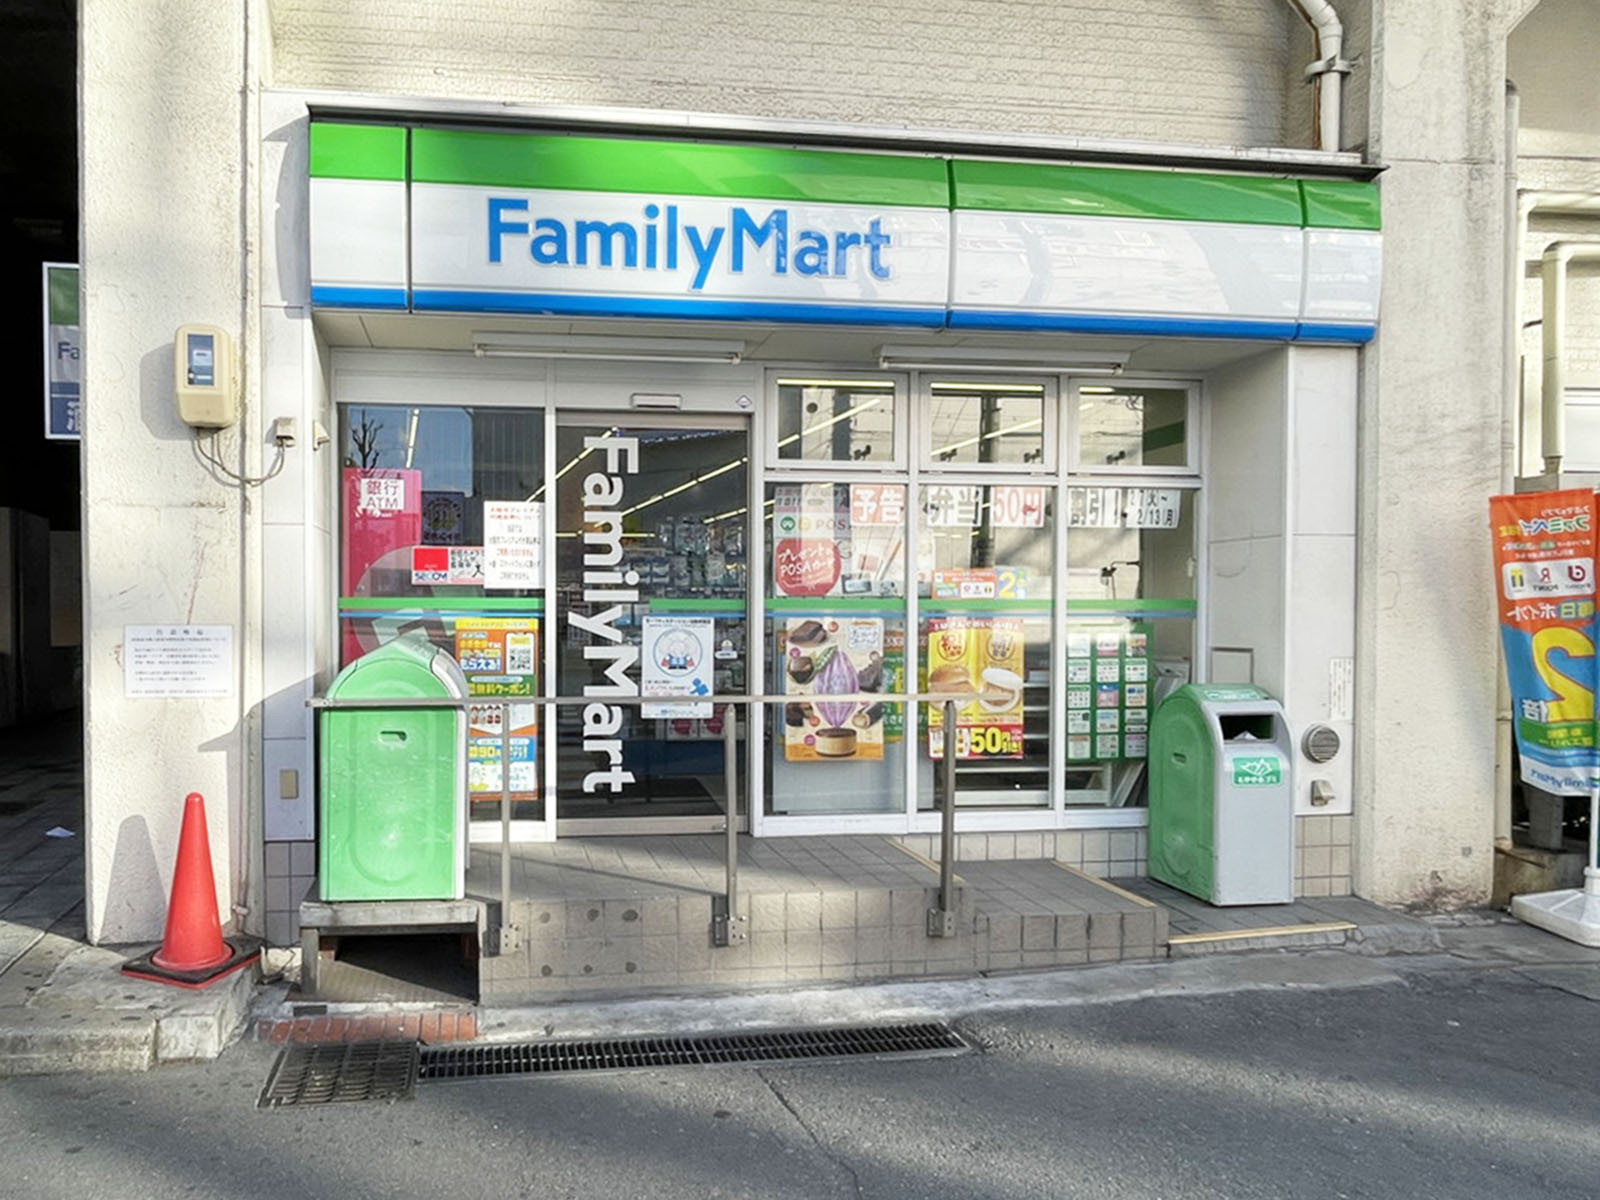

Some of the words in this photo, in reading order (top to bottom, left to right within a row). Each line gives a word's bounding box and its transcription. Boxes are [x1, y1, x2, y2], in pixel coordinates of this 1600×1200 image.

[487, 197, 892, 291] FamilyMart
[366, 479, 399, 496] 銀行
[366, 496, 398, 508] ATM
[854, 487, 905, 523] 予告
[931, 487, 980, 525] 弁当
[993, 487, 1042, 526] 50円
[415, 572, 447, 581] SECOM
[568, 436, 639, 793] FamilyMart
